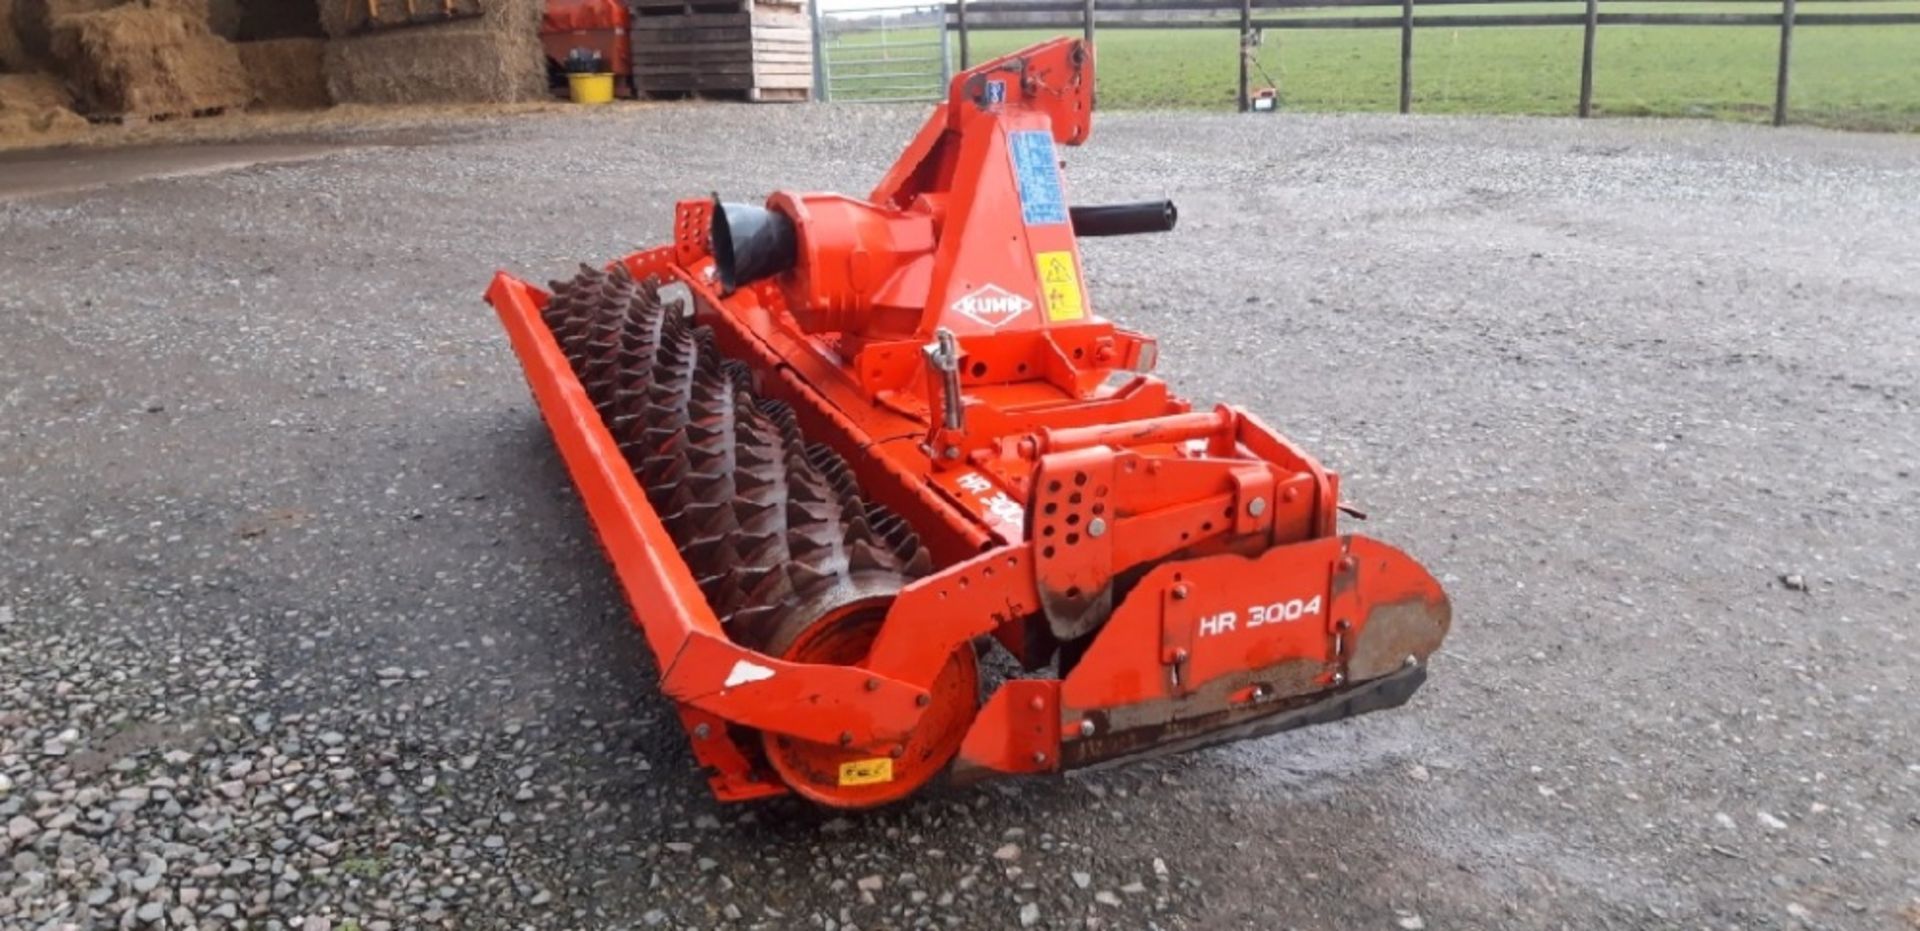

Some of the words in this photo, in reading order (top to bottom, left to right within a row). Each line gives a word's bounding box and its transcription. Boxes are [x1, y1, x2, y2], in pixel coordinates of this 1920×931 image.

[961, 296, 1024, 314] KUHN
[956, 472, 992, 495] HR
[1199, 611, 1237, 637] HR
[1246, 595, 1321, 628] 3004
